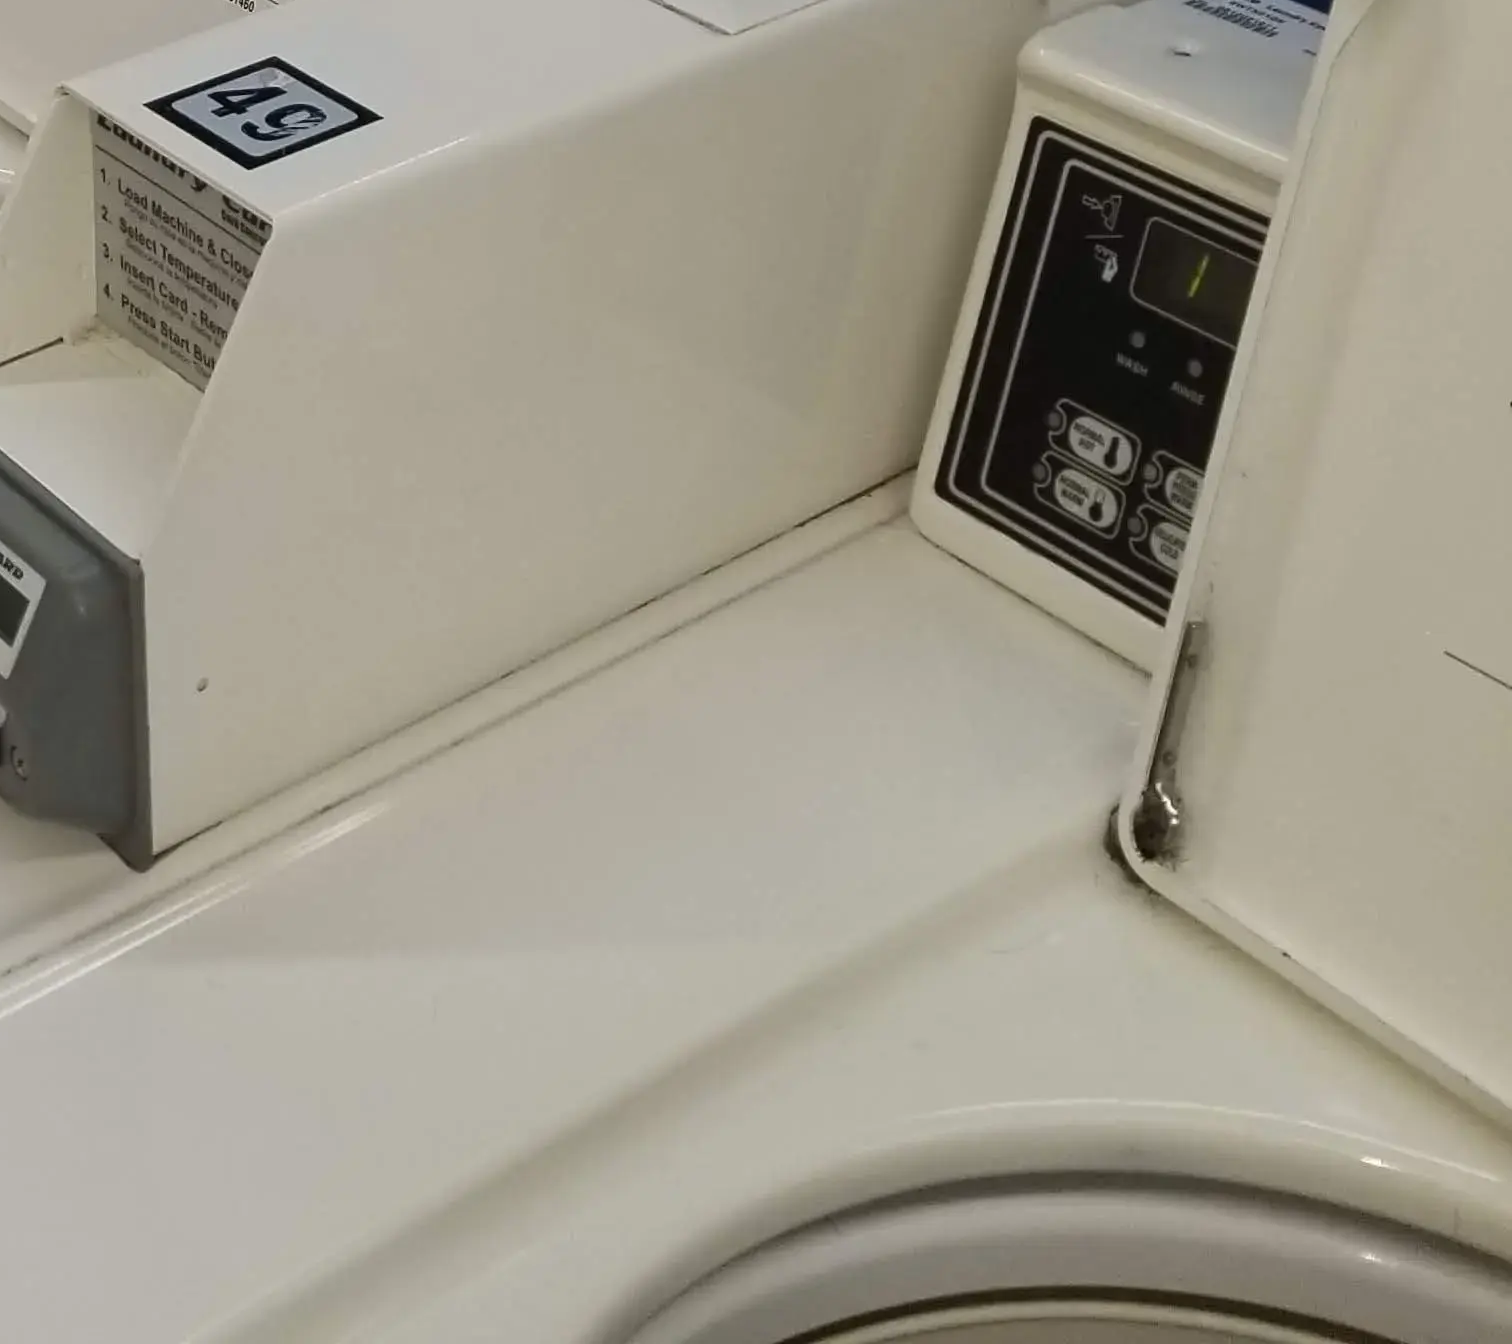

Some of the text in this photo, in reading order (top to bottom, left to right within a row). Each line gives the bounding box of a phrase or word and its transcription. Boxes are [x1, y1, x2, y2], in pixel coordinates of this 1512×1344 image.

[207, 86, 327, 141] 49
[118, 178, 147, 210] Load
[152, 200, 203, 248] Machine
[207, 239, 216, 256] &
[119, 217, 157, 254] Select
[120, 255, 154, 289] Insert
[159, 282, 187, 312] Card
[121, 294, 156, 329] Press
[160, 321, 190, 353] Start
